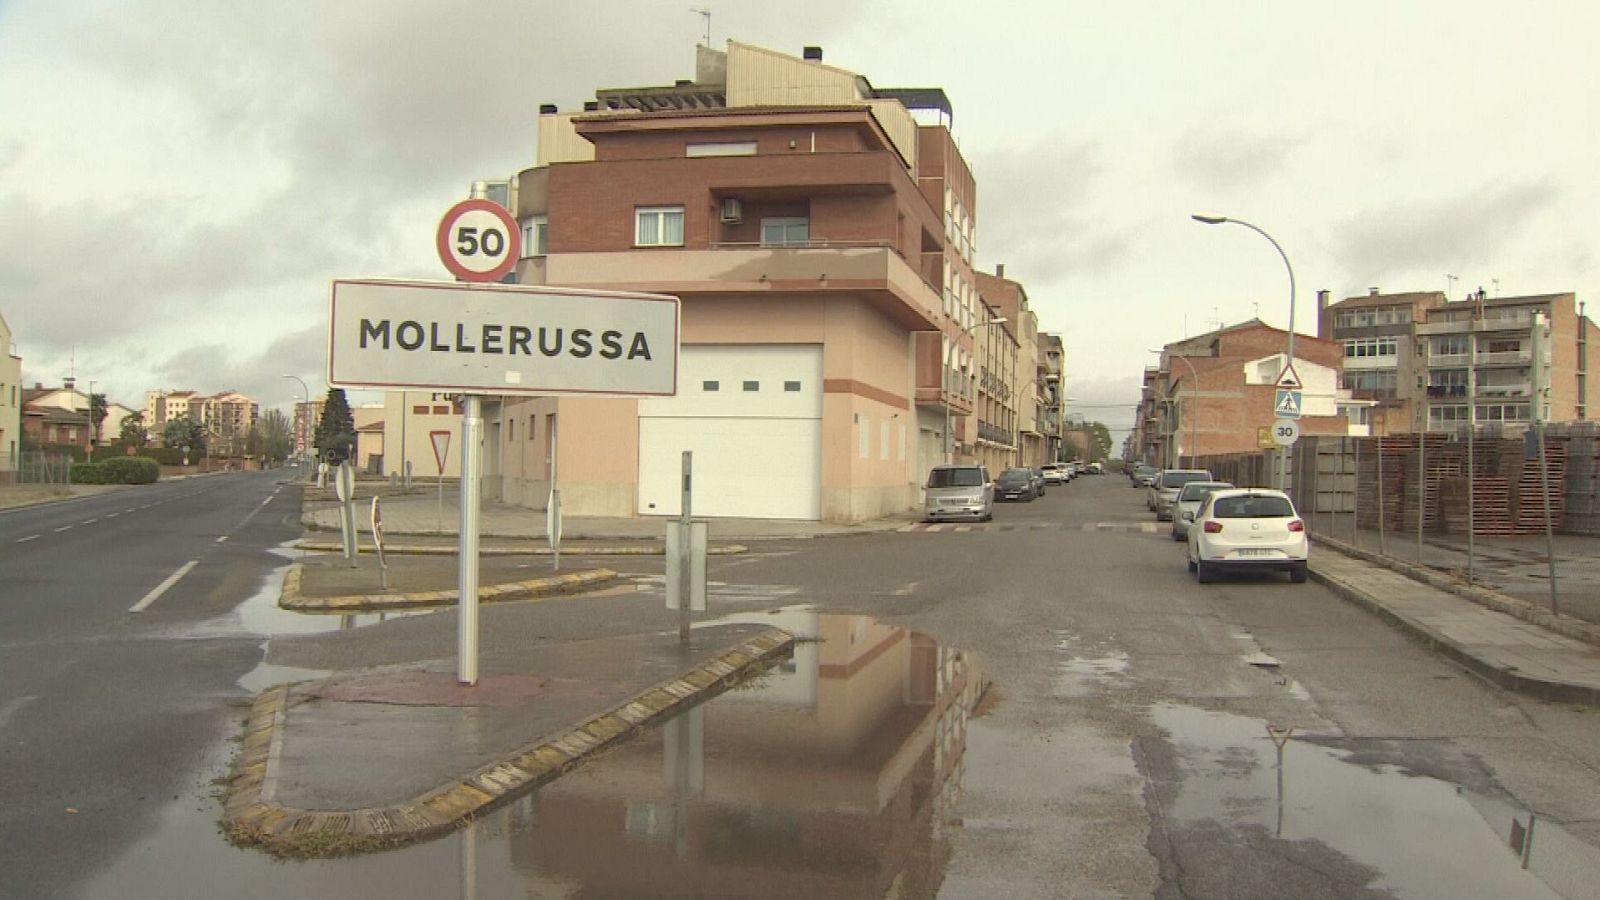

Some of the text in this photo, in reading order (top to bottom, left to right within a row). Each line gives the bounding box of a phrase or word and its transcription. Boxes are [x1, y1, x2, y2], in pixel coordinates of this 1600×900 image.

[457, 227, 505, 256] 50
[359, 318, 652, 360] MOLLERUSSA
[1277, 427, 1293, 437] 30
